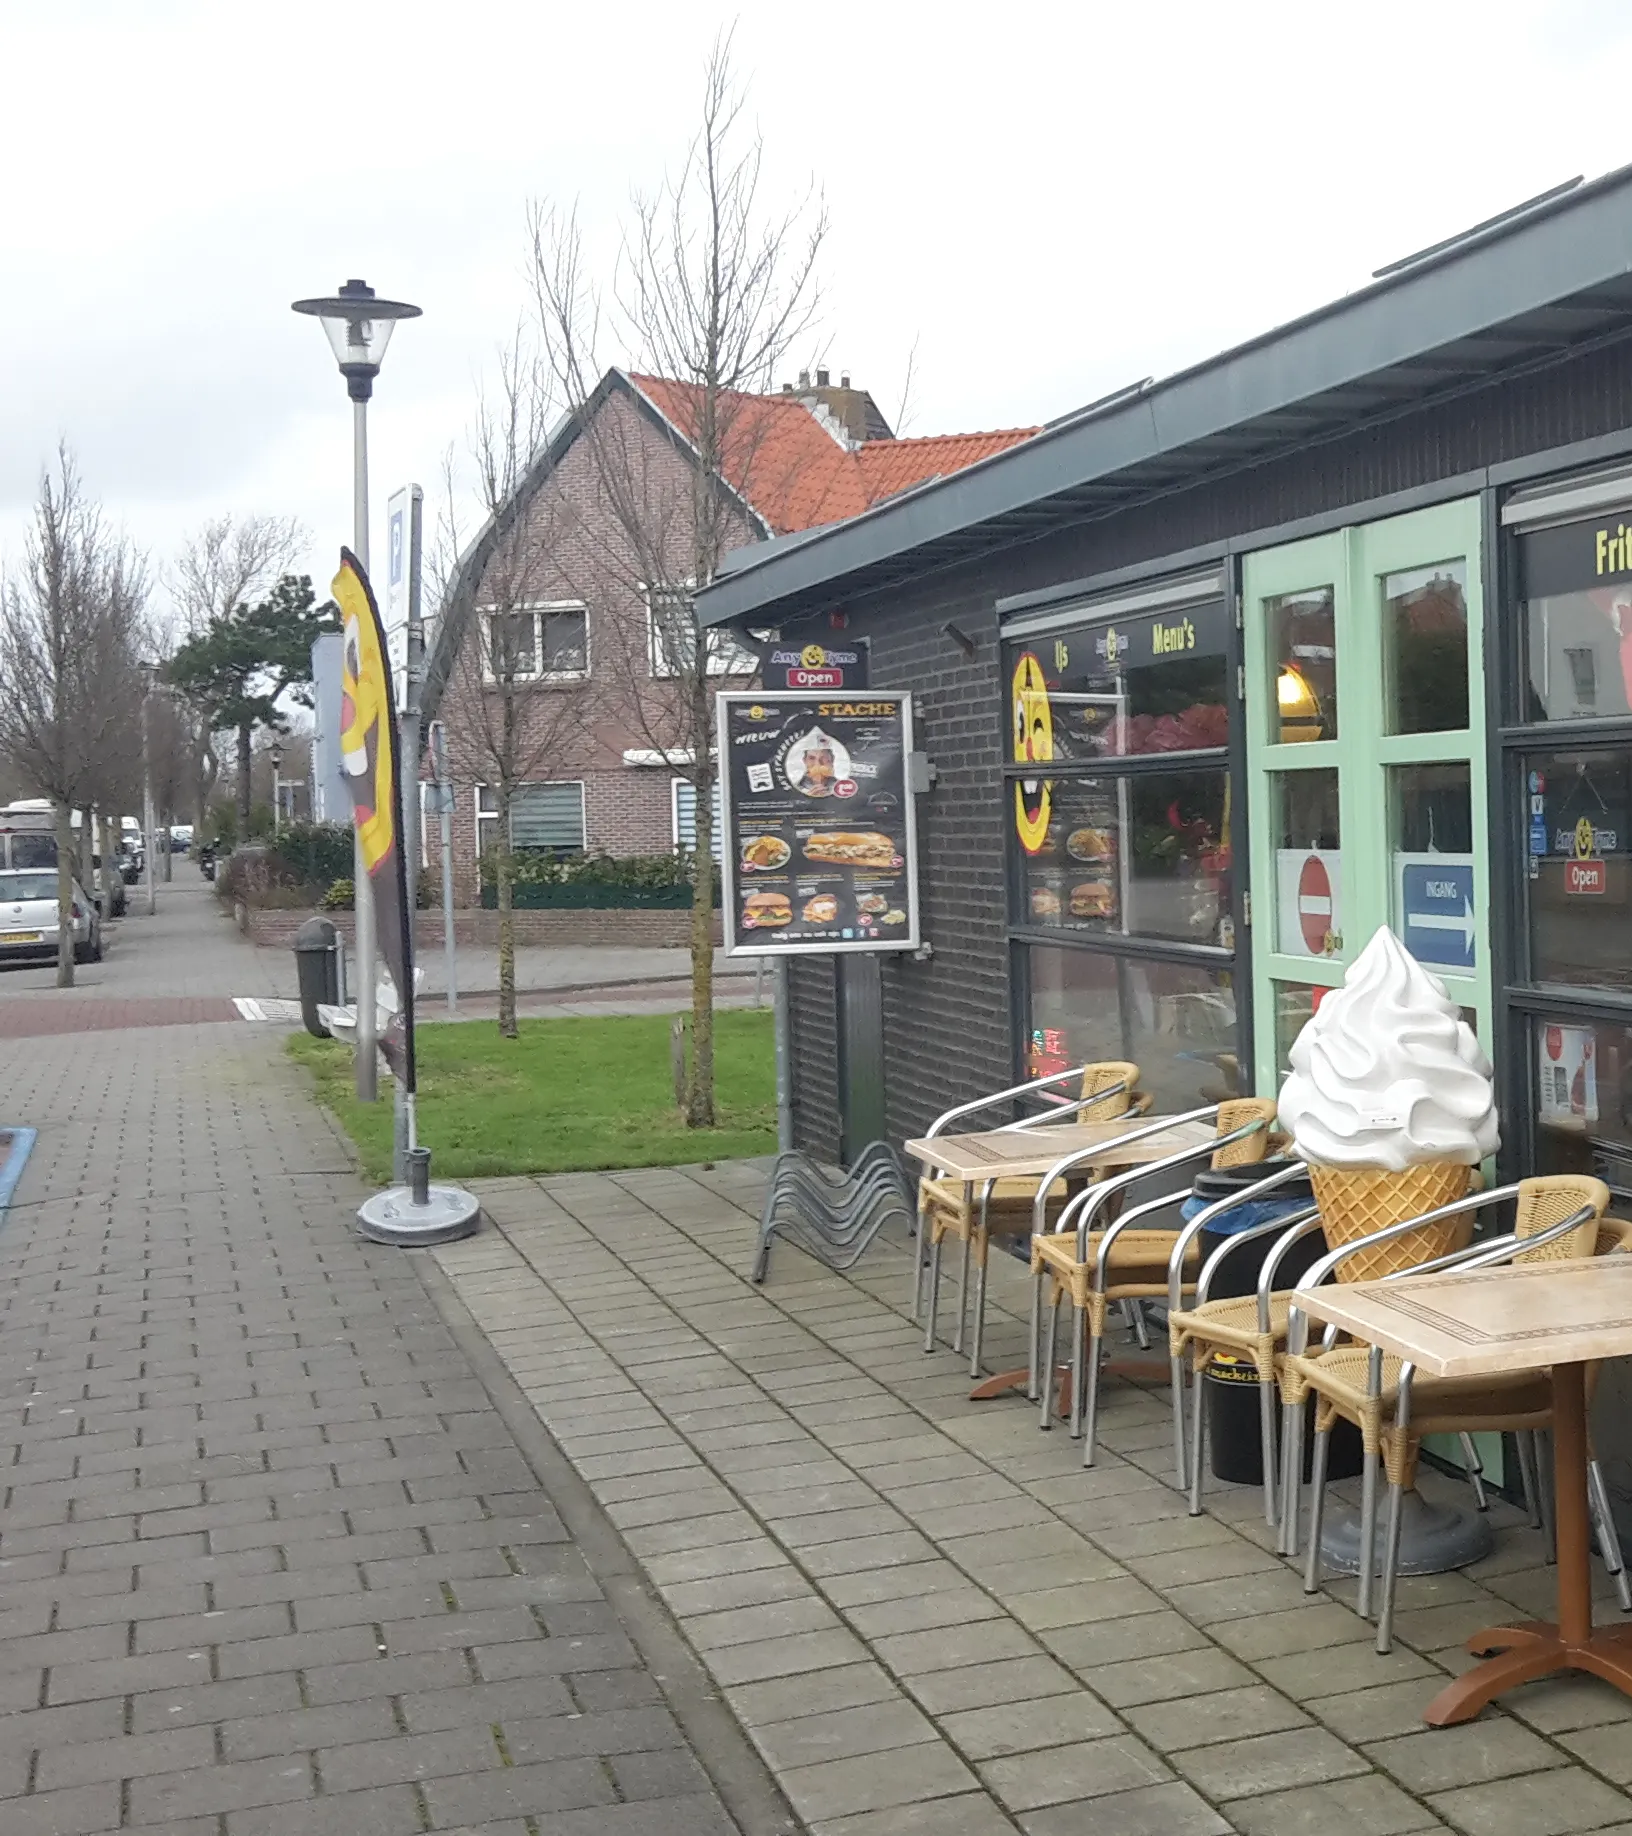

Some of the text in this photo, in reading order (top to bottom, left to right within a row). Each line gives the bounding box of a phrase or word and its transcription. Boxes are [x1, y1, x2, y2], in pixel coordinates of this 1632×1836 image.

[1153, 617, 1195, 655] Menu's
[771, 651, 801, 667] Any
[797, 672, 833, 687] Open
[818, 703, 897, 717] STACHE
[1571, 866, 1598, 892] Open
[1426, 881, 1457, 898] INGANG
